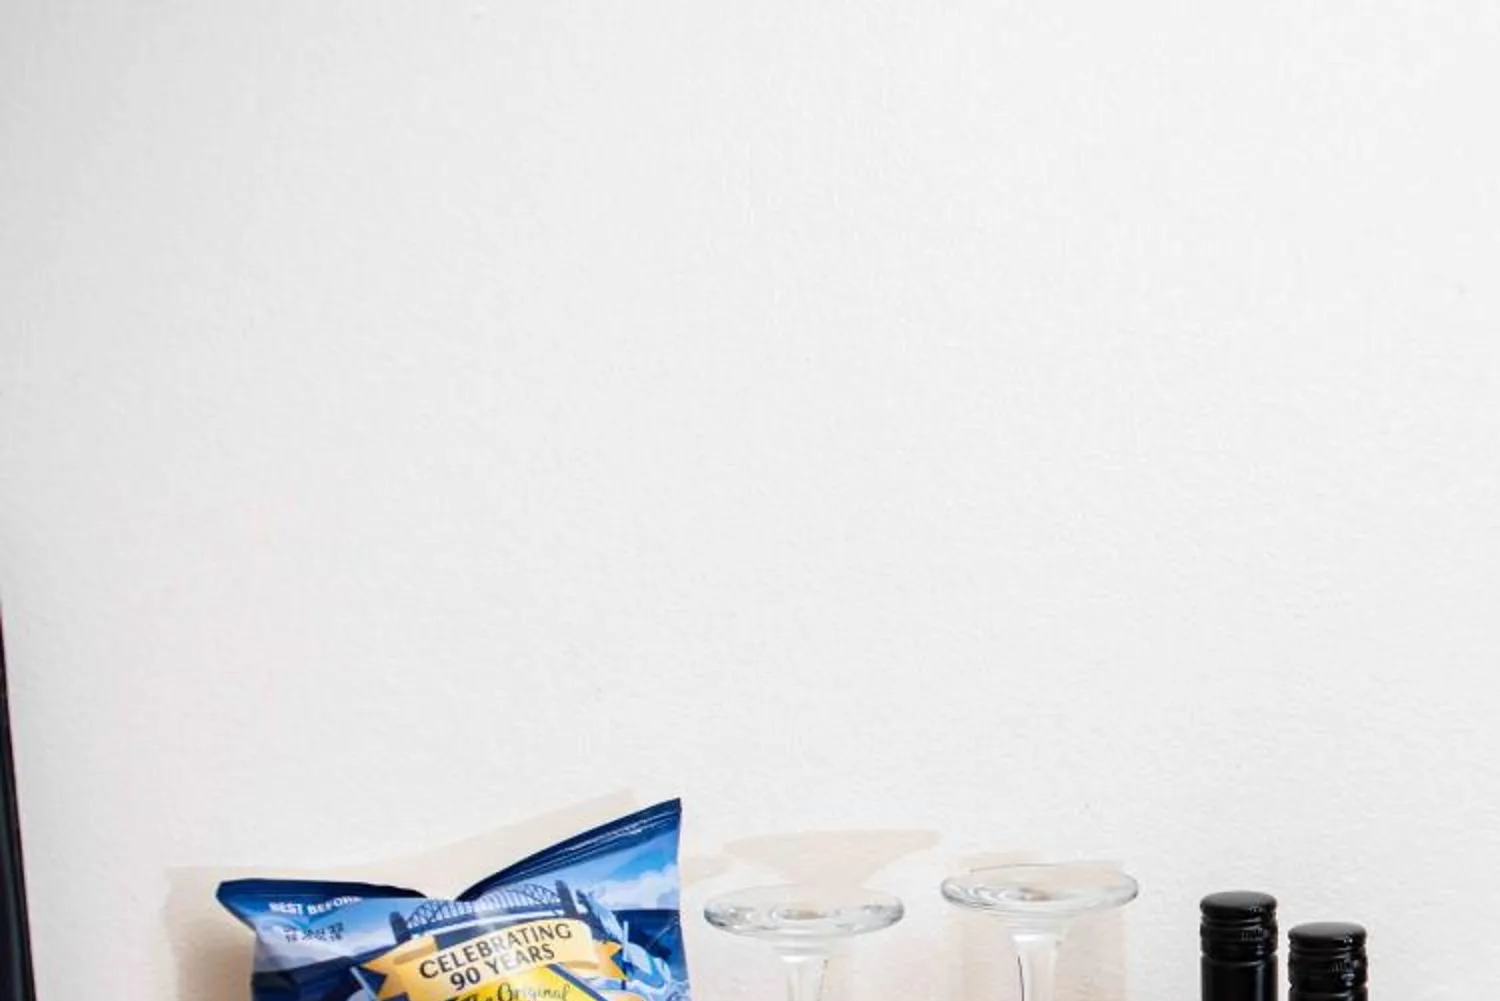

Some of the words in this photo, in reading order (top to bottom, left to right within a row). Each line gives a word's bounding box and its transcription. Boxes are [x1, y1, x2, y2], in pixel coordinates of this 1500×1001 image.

[419, 922, 572, 979] CELEBRATING
[450, 966, 481, 991] 90
[485, 943, 555, 975] YEARS
